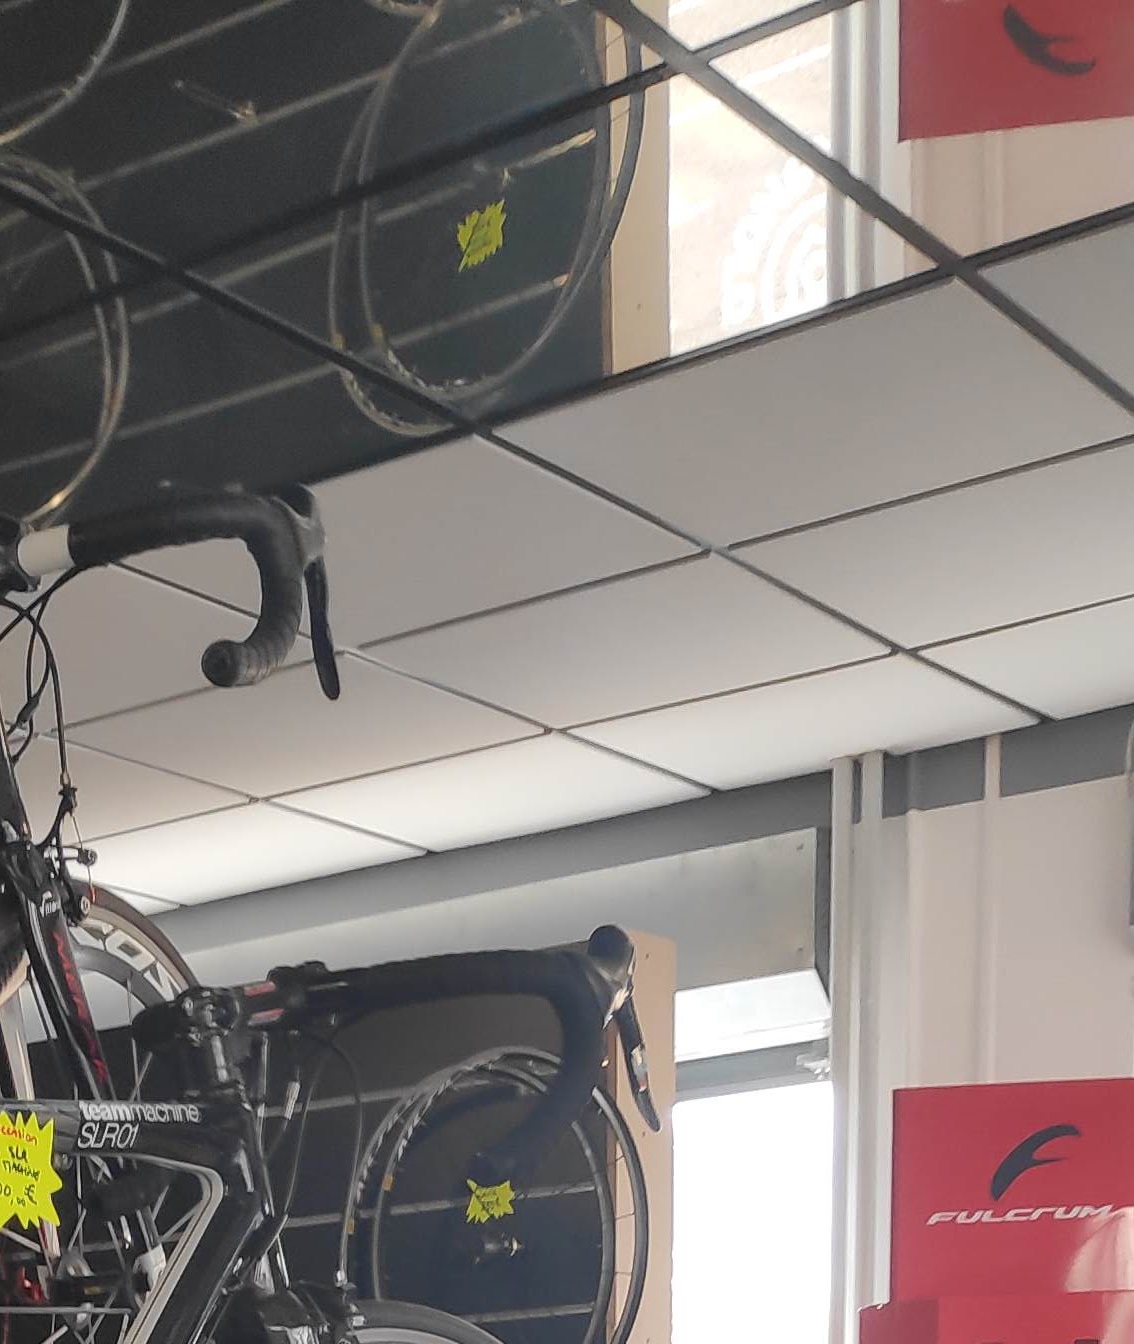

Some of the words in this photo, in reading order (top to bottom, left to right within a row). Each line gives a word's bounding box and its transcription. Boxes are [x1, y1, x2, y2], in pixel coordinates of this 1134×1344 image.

[79, 1102, 199, 1123] teammachine
[78, 1122, 139, 1149] SLR01
[926, 1204, 1114, 1226] FULCRUM
